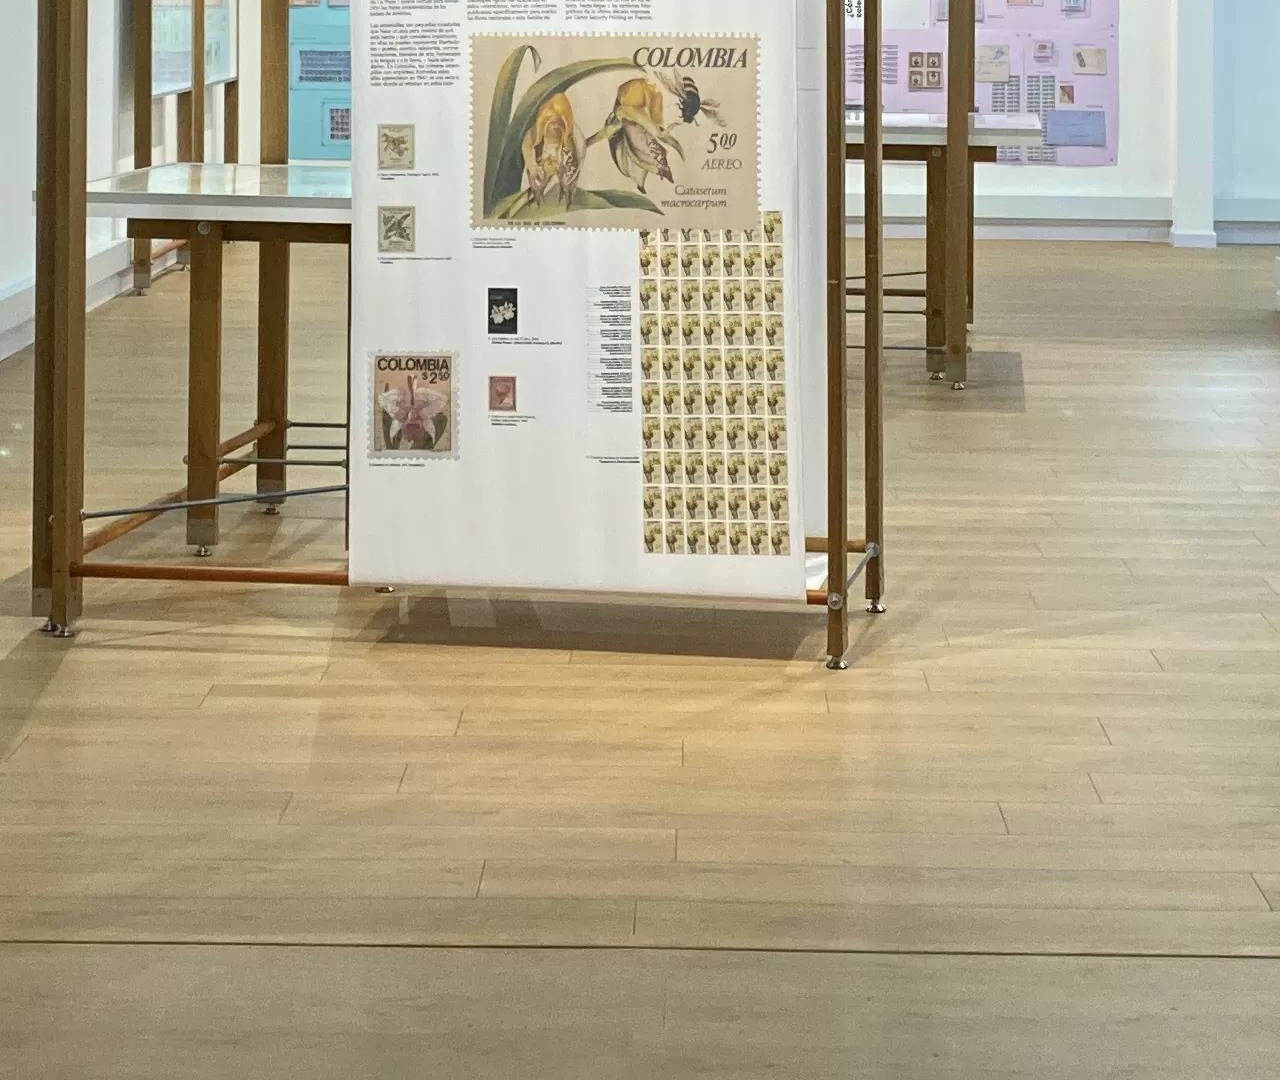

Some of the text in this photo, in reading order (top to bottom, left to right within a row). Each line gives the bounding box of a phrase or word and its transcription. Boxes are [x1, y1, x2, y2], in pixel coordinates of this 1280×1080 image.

[632, 47, 748, 69] COLOMBIA
[701, 158, 742, 170] AEREO
[661, 198, 727, 210] macrocarpum
[377, 357, 449, 372] COLOMBIA
